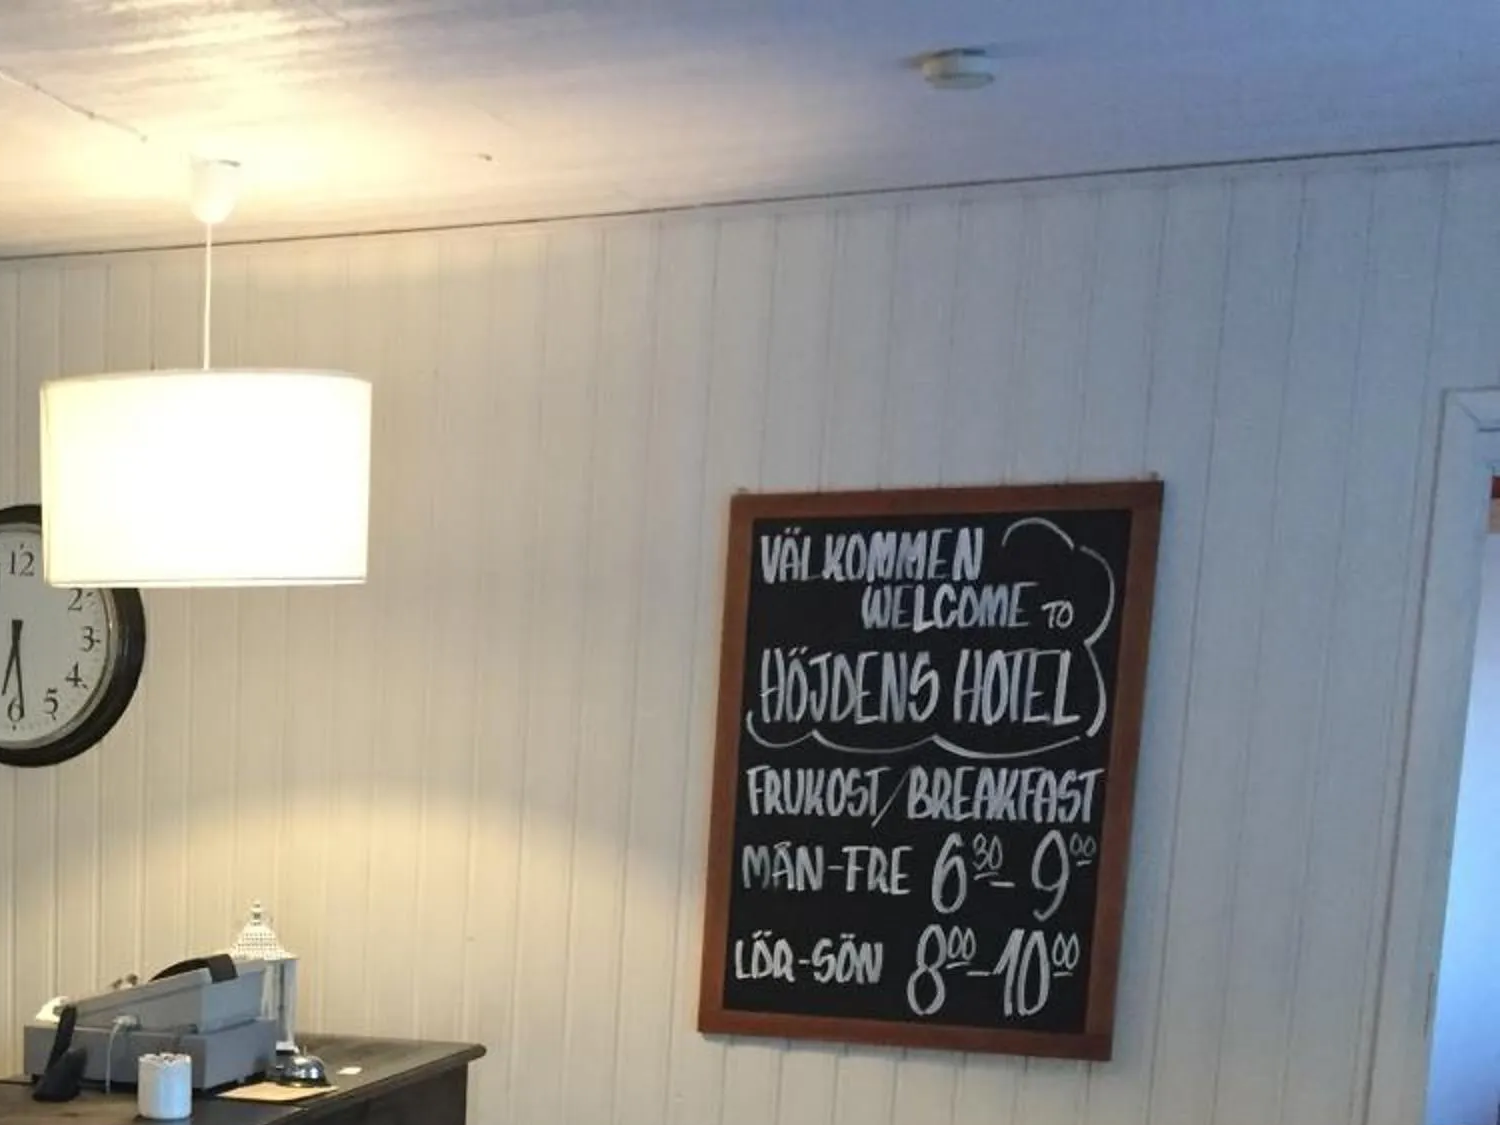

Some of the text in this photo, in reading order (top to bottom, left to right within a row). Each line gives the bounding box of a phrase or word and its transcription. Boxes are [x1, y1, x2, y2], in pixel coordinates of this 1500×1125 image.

[8, 550, 35, 577] 12
[760, 526, 984, 584] VÄLKOMMEN
[67, 587, 83, 611] 2
[861, 581, 1075, 634] WELCOME TO
[81, 625, 95, 652] 3
[65, 661, 83, 689] 4
[759, 645, 1081, 726] HÖJDENS HOTEL
[6, 699, 24, 723] 6
[43, 687, 59, 715] 5
